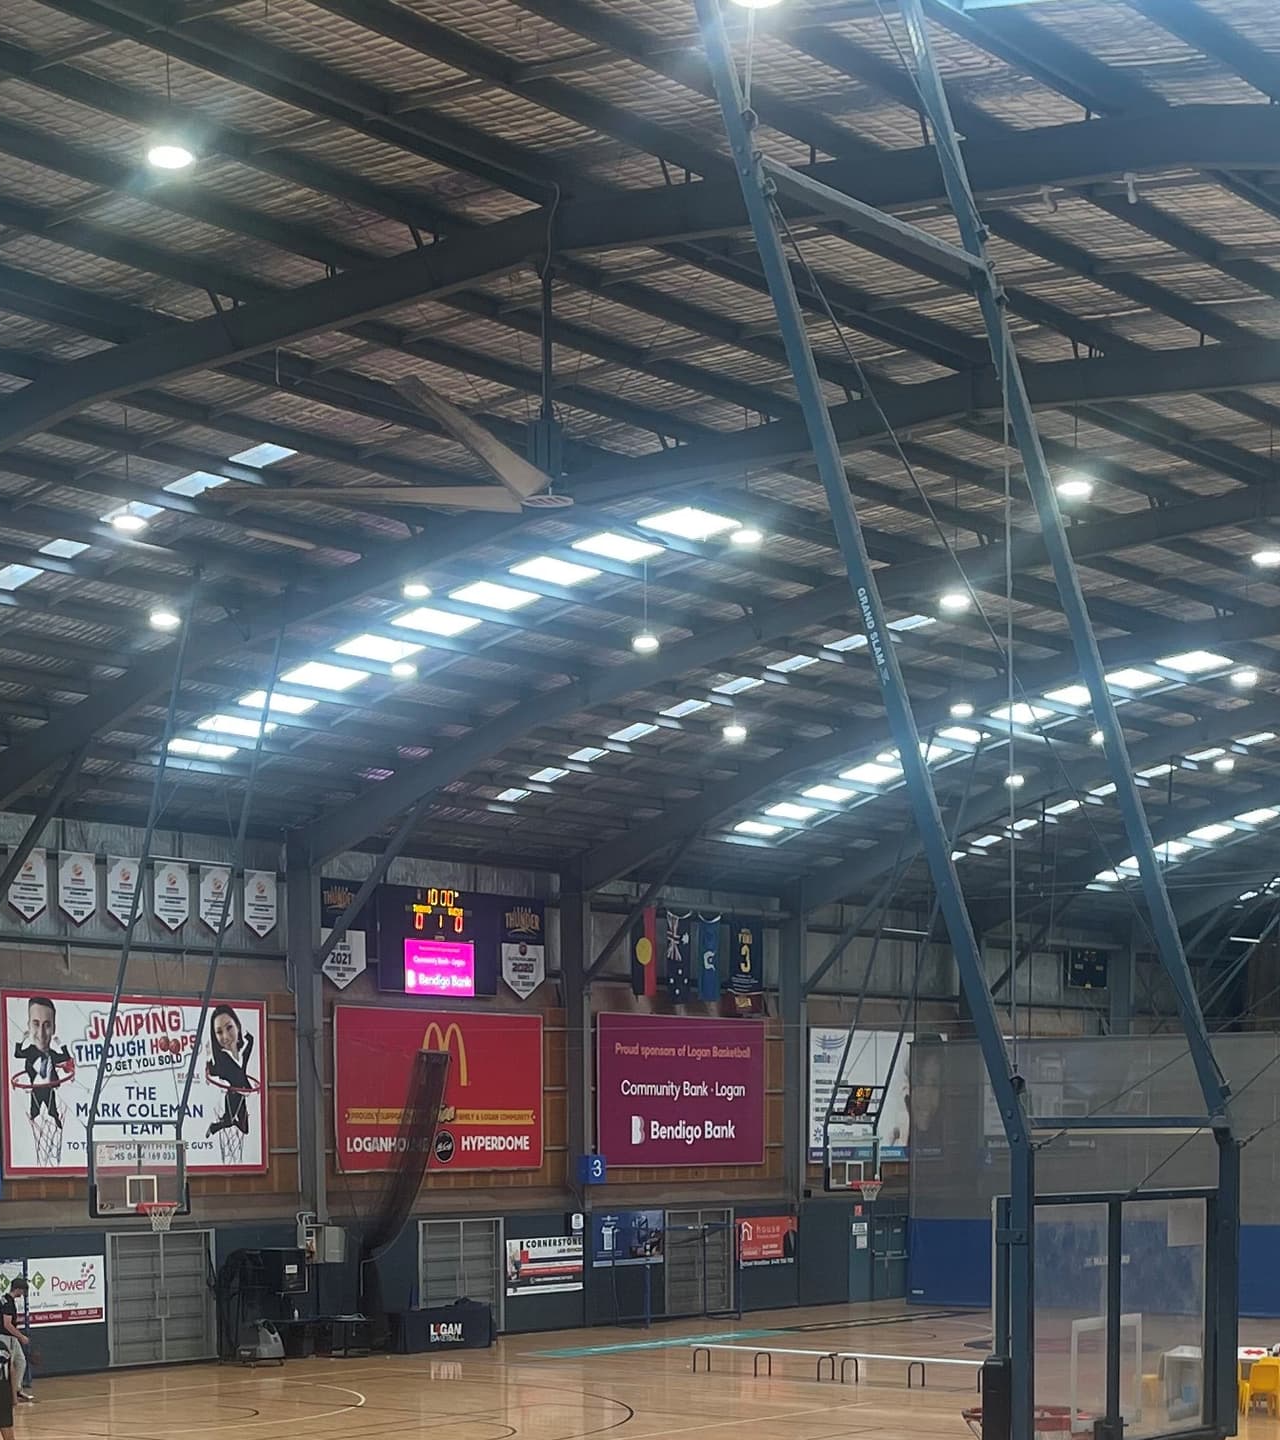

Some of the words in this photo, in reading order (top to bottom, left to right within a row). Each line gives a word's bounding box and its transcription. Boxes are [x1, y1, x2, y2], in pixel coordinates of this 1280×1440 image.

[505, 910, 540, 930] THUNDER
[331, 951, 352, 966] 2021
[740, 945, 751, 973] 3
[418, 973, 450, 989] Bendigo
[451, 974, 471, 987] Bank
[615, 1043, 639, 1055] Proud
[641, 1047, 675, 1059] sponsors
[677, 1045, 686, 1056] of
[688, 1045, 710, 1060] Logan
[712, 1046, 751, 1059] Basketball
[115, 1059, 133, 1071] GET
[135, 1057, 156, 1069] YOU
[158, 1054, 183, 1068] SOLD
[125, 1086, 157, 1101] THE
[621, 1080, 680, 1101] Community
[683, 1081, 708, 1097] Bank
[715, 1082, 746, 1101] Logan
[127, 1103, 204, 1118] COLEMAN
[122, 1124, 163, 1136] TEAM
[650, 1121, 701, 1145] Bendigo
[704, 1120, 735, 1139] Bank
[191, 1141, 214, 1150] GUYS
[461, 1136, 530, 1150] HYPERDOME
[592, 1159, 602, 1177] 3
[756, 1224, 780, 1233] house
[526, 1237, 583, 1248] CORNERSTONE
[51, 1274, 96, 1291] Power2
